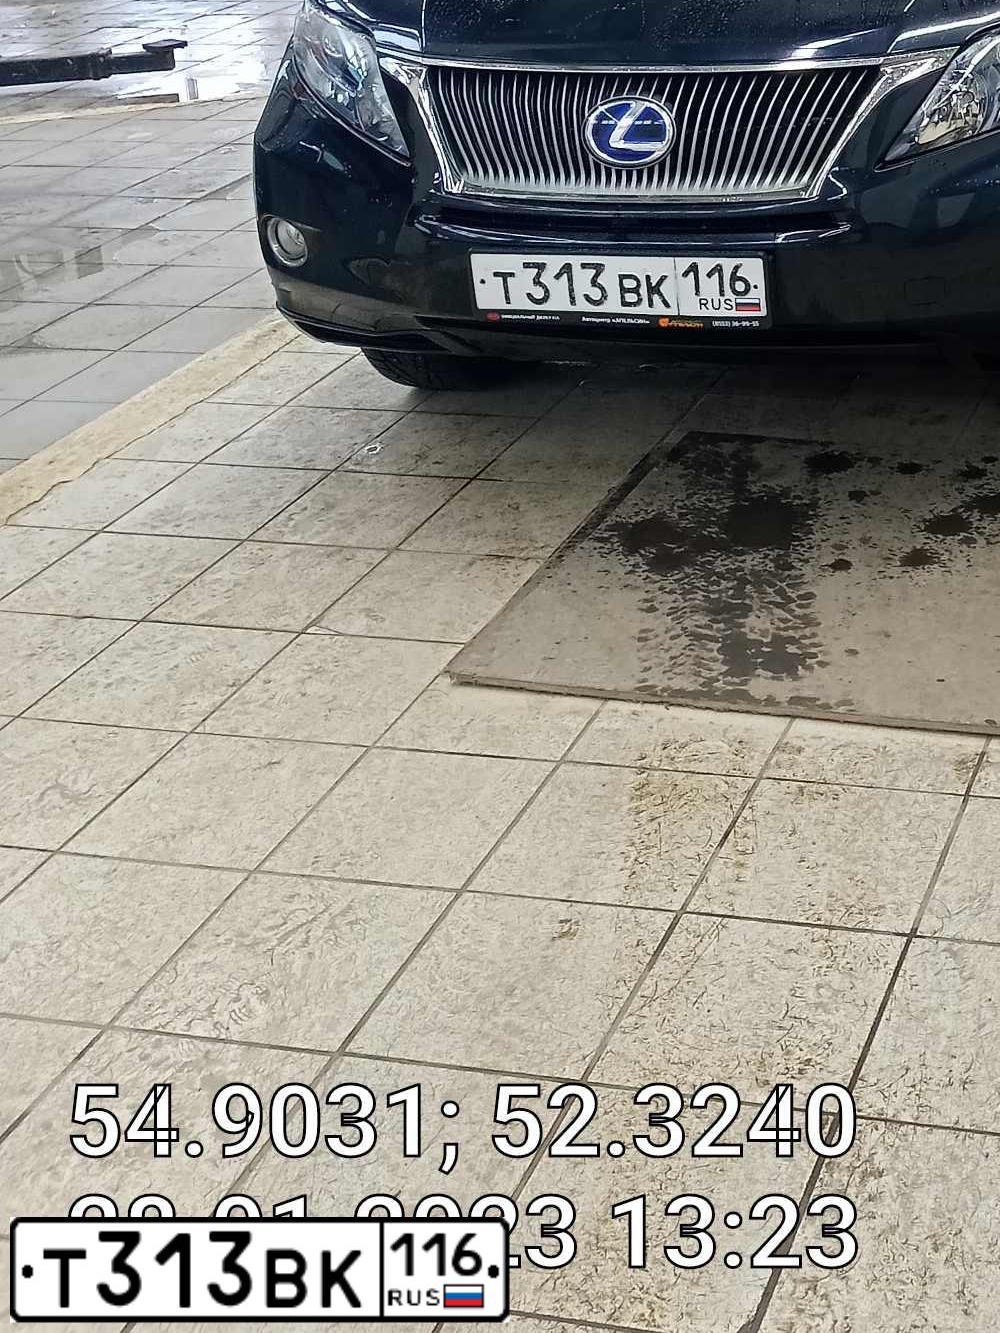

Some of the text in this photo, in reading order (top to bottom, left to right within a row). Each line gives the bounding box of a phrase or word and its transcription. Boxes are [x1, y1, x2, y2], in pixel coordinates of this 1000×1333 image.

[492, 261, 751, 310] Т313ВК 116
[699, 297, 734, 312] RUS
